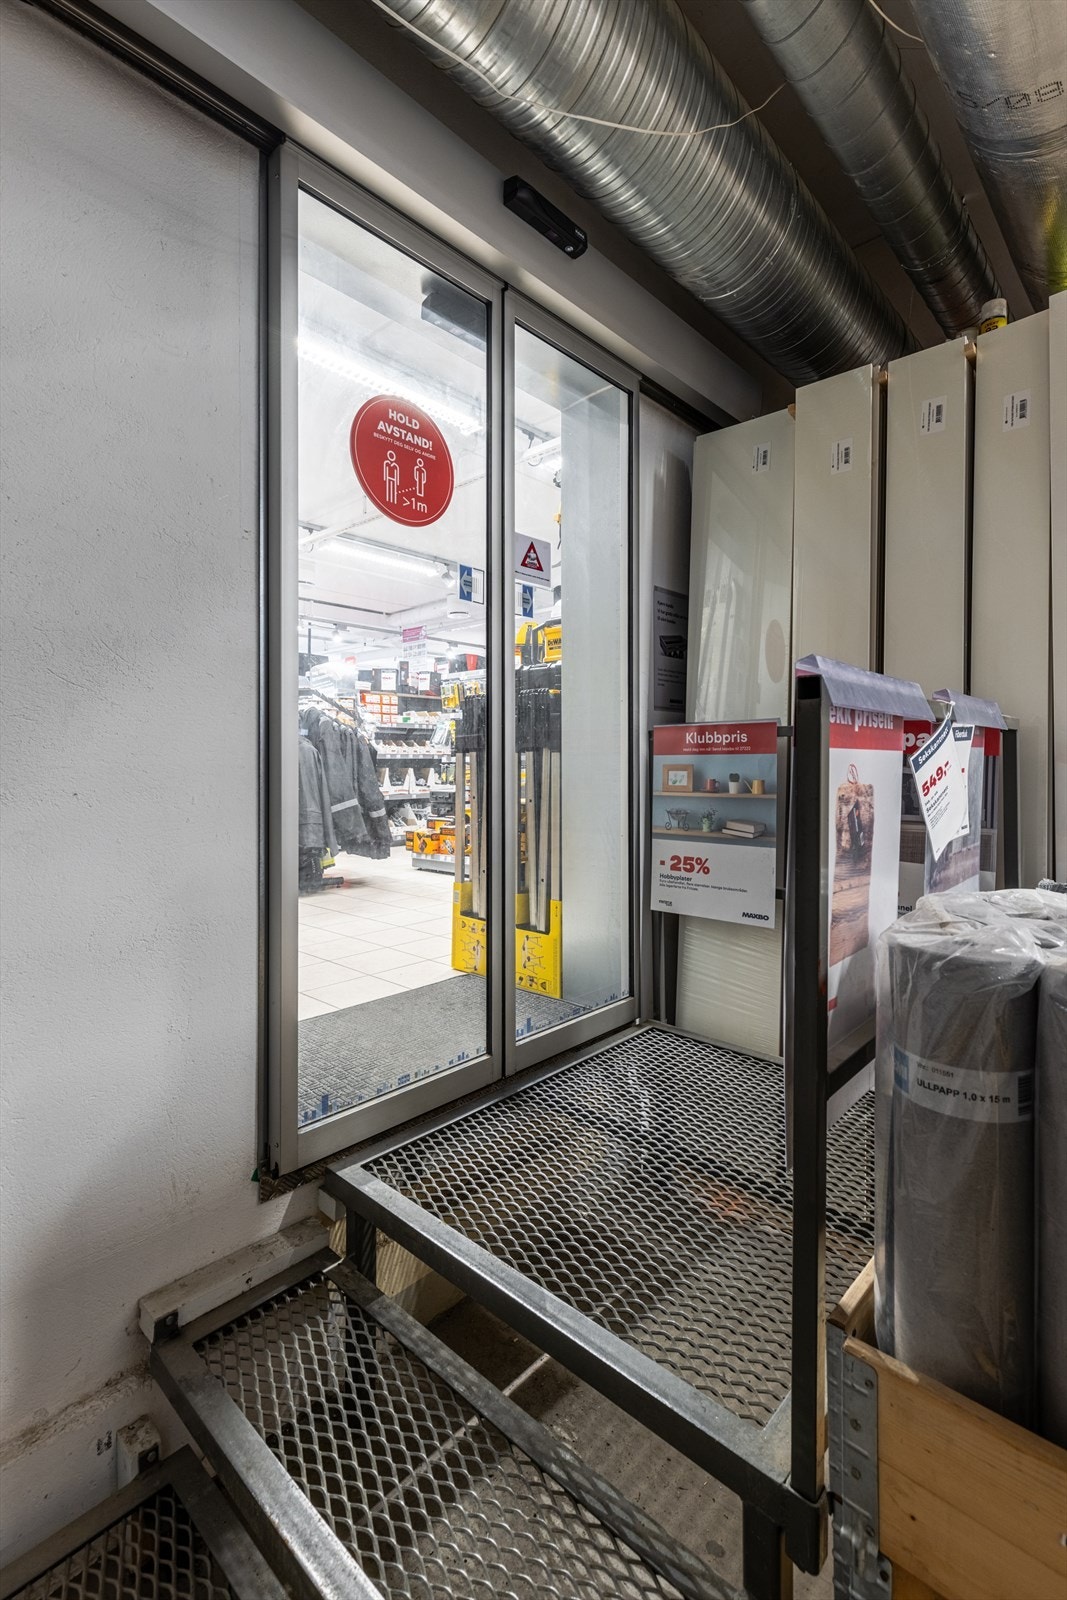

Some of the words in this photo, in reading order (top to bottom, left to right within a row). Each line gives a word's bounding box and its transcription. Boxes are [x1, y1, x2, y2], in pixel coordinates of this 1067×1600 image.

[388, 408, 420, 430] HOLD
[377, 420, 433, 451] AVSTAND!
[686, 730, 748, 745] Klubbpris
[921, 760, 949, 797] 549,-
[670, 854, 710, 875] 25%
[659, 873, 692, 882] Hobbyplater
[742, 911, 769, 921] MAXBO
[916, 1078, 960, 1097] ULLPAPP
[980, 1095, 986, 1103] x
[989, 1095, 1000, 1104] 15
[1002, 1096, 1011, 1104] m
